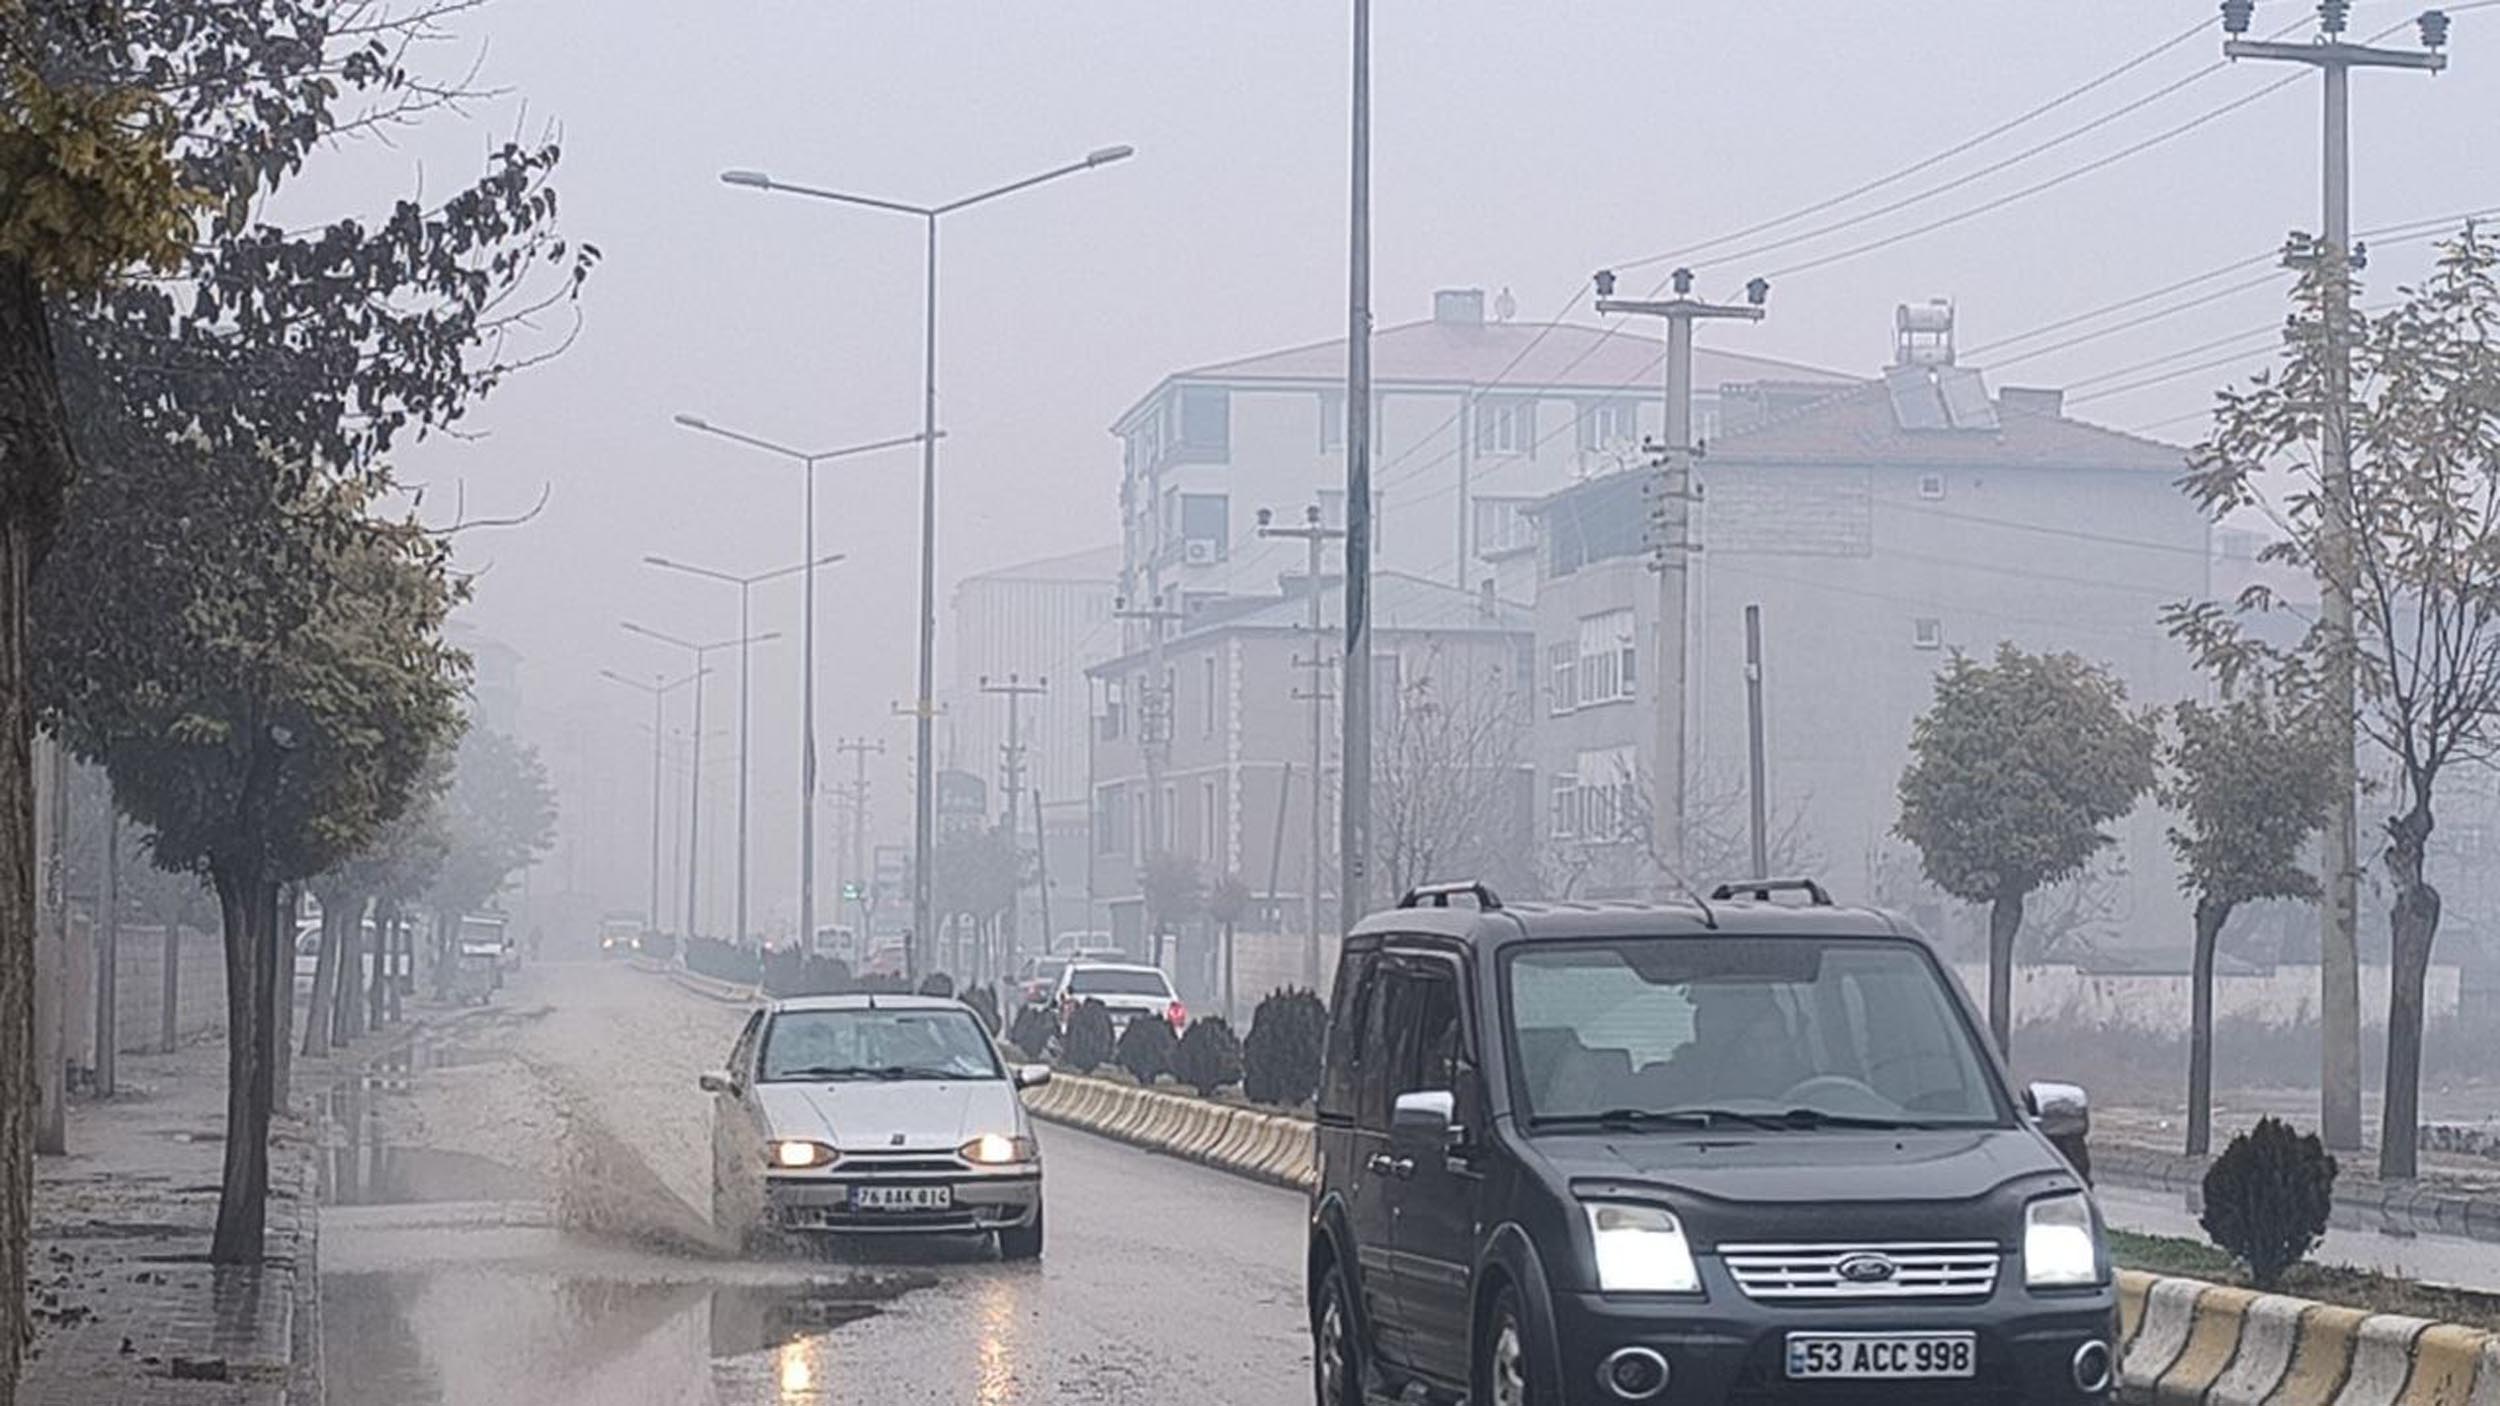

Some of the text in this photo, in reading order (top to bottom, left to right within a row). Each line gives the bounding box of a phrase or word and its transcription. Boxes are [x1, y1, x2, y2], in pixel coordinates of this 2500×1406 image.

[1806, 1343, 1842, 1372] 53
[1852, 1343, 1909, 1372] ACC
[1914, 1342, 1969, 1371] 998
